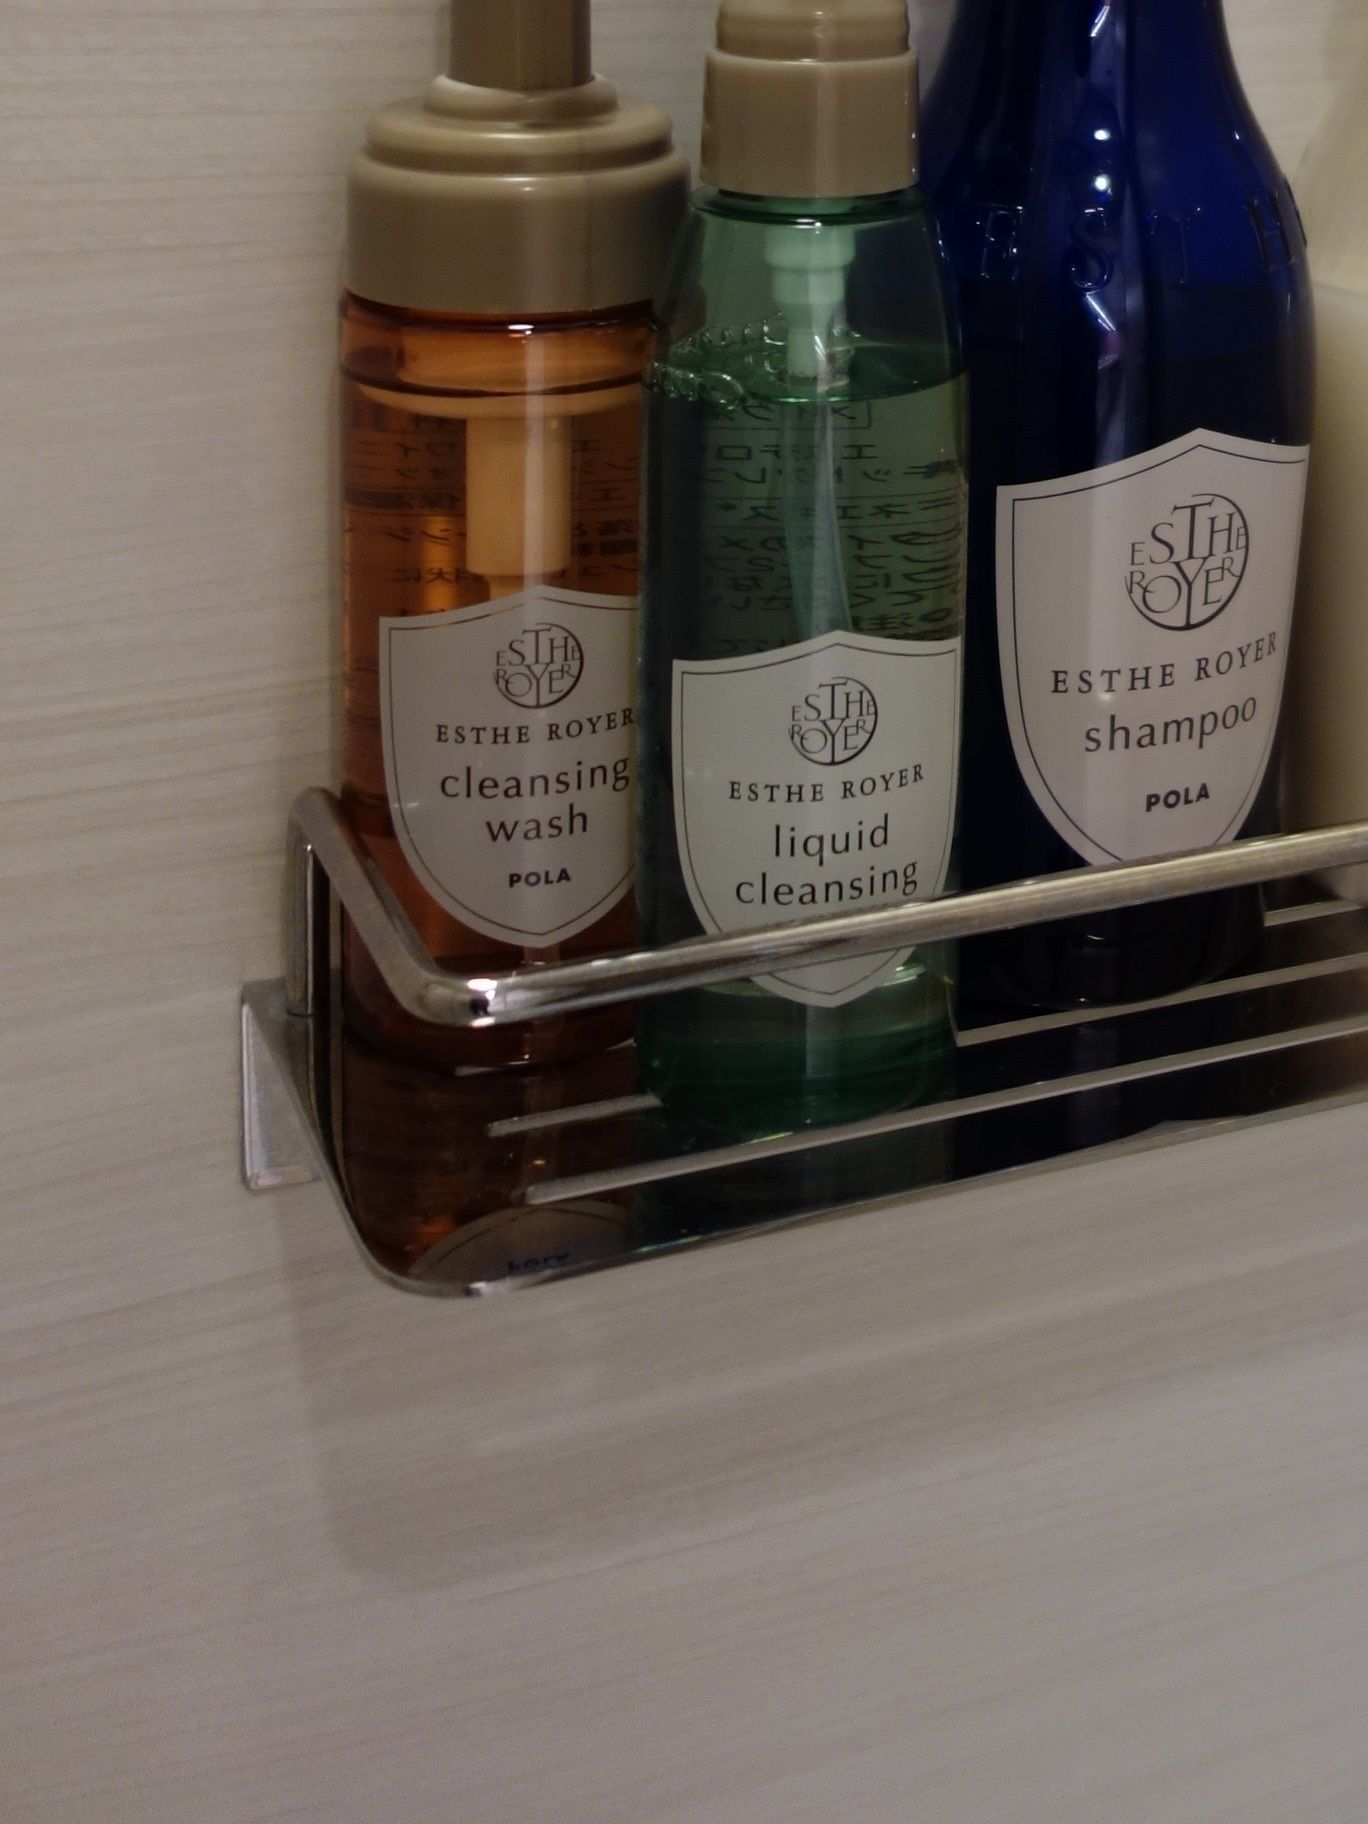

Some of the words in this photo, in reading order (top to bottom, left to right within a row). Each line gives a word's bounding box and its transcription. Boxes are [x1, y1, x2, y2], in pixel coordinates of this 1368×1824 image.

[1051, 662, 1176, 694] ESTHE
[1194, 631, 1278, 682] ROYER
[435, 723, 531, 745] ESTHE
[546, 706, 635, 742] ROYER
[1084, 697, 1257, 753] shampoo
[440, 755, 631, 800] cleansing
[728, 780, 824, 803] ESTHE
[841, 763, 924, 799] ROYER
[1145, 783, 1210, 812] POLA
[485, 804, 589, 844] wash
[773, 813, 890, 866] liquid
[508, 867, 572, 888] POLA
[735, 860, 919, 906] cleansing
